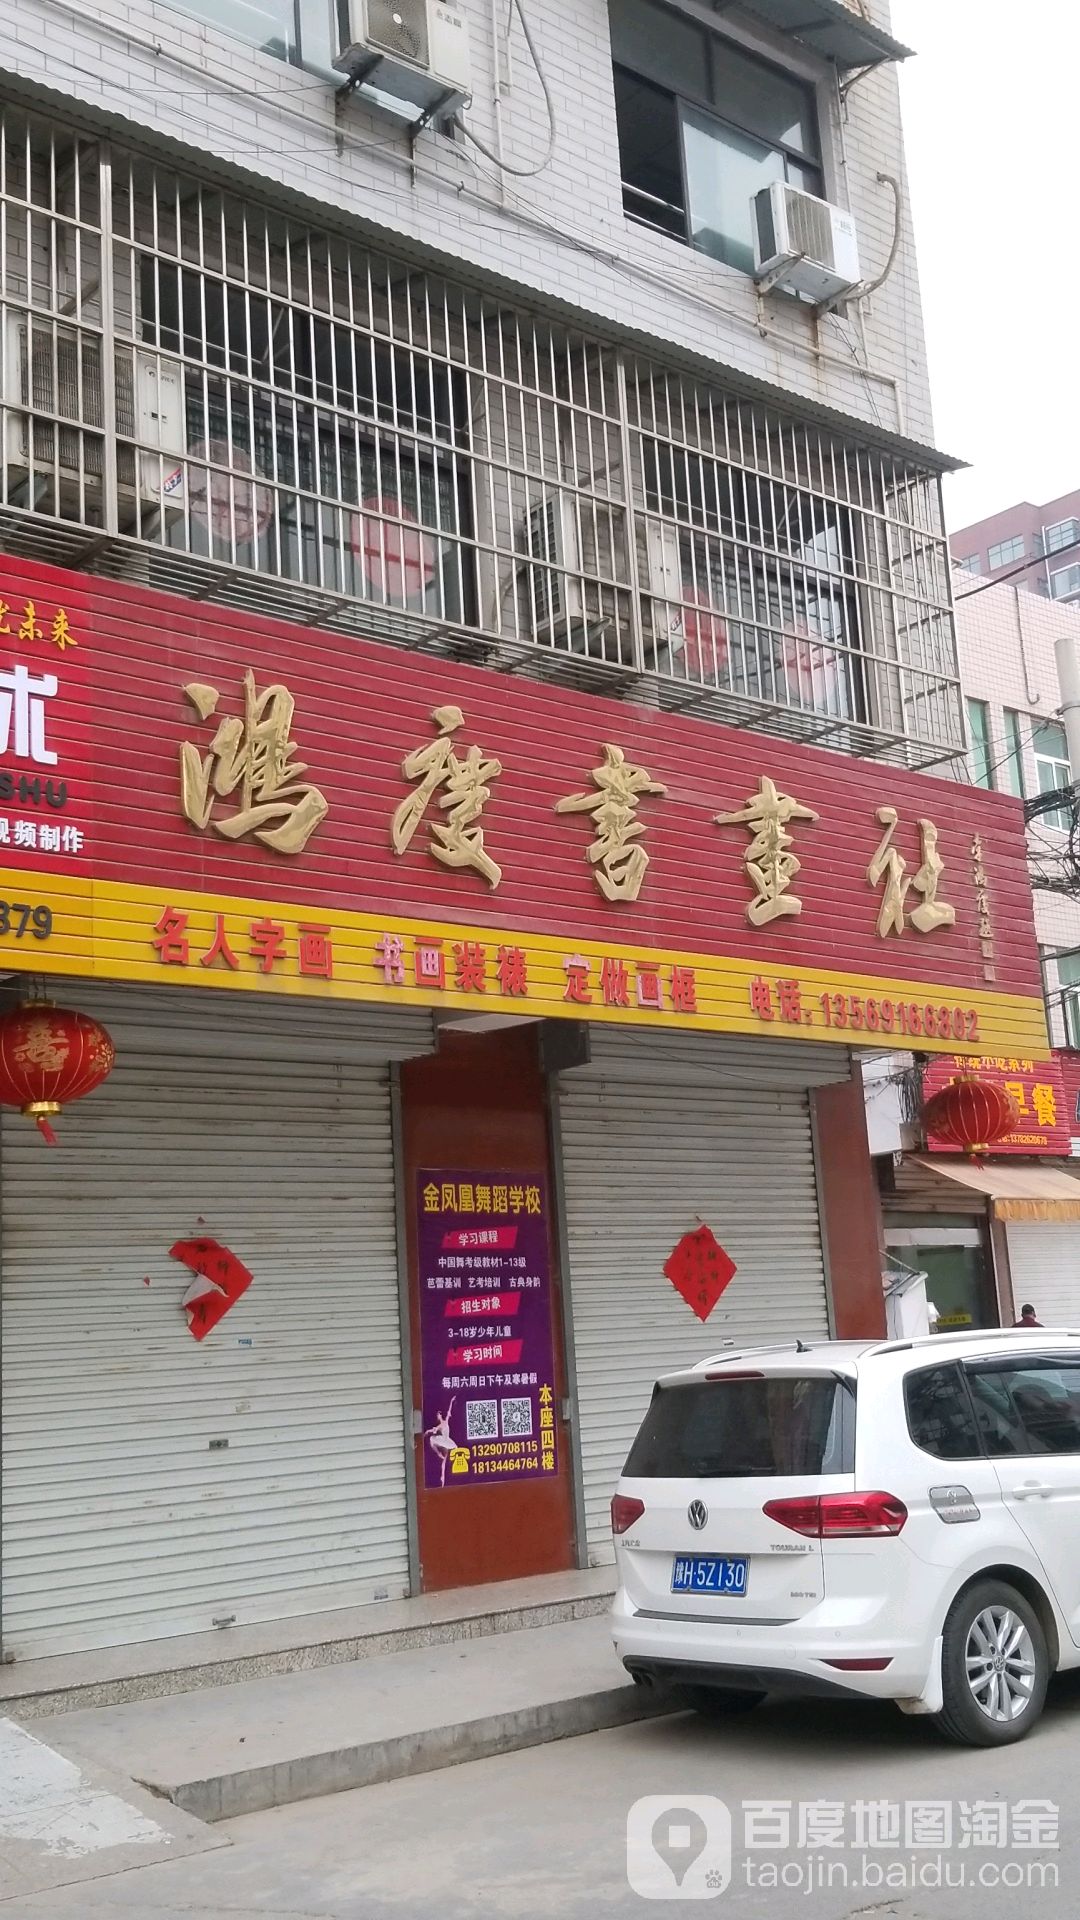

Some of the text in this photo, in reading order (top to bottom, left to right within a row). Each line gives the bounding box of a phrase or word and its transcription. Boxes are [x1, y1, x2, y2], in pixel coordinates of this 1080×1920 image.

[153, 905, 332, 979] 名人字画
[373, 932, 528, 995] 书画装裱
[563, 953, 697, 1012] 定做画框
[423, 1183, 541, 1214] 金凤凰舞蹈学校
[458, 1231, 498, 1246] 学习课程
[438, 1256, 526, 1268] 中国舞考级教材1-13级
[427, 1277, 461, 1288] 芭蕾基训
[468, 1277, 501, 1288] 艺考培训
[461, 1297, 501, 1314] 招生对象
[448, 1325, 512, 1338] 3-18岁少年儿童
[462, 1345, 503, 1363] 学习时间
[442, 1372, 537, 1389] 每周六周日下午及寒暑假
[539, 1383, 555, 1470] 本座四楼
[471, 1440, 538, 1457] 13290708115
[472, 1457, 538, 1474] 18134464764
